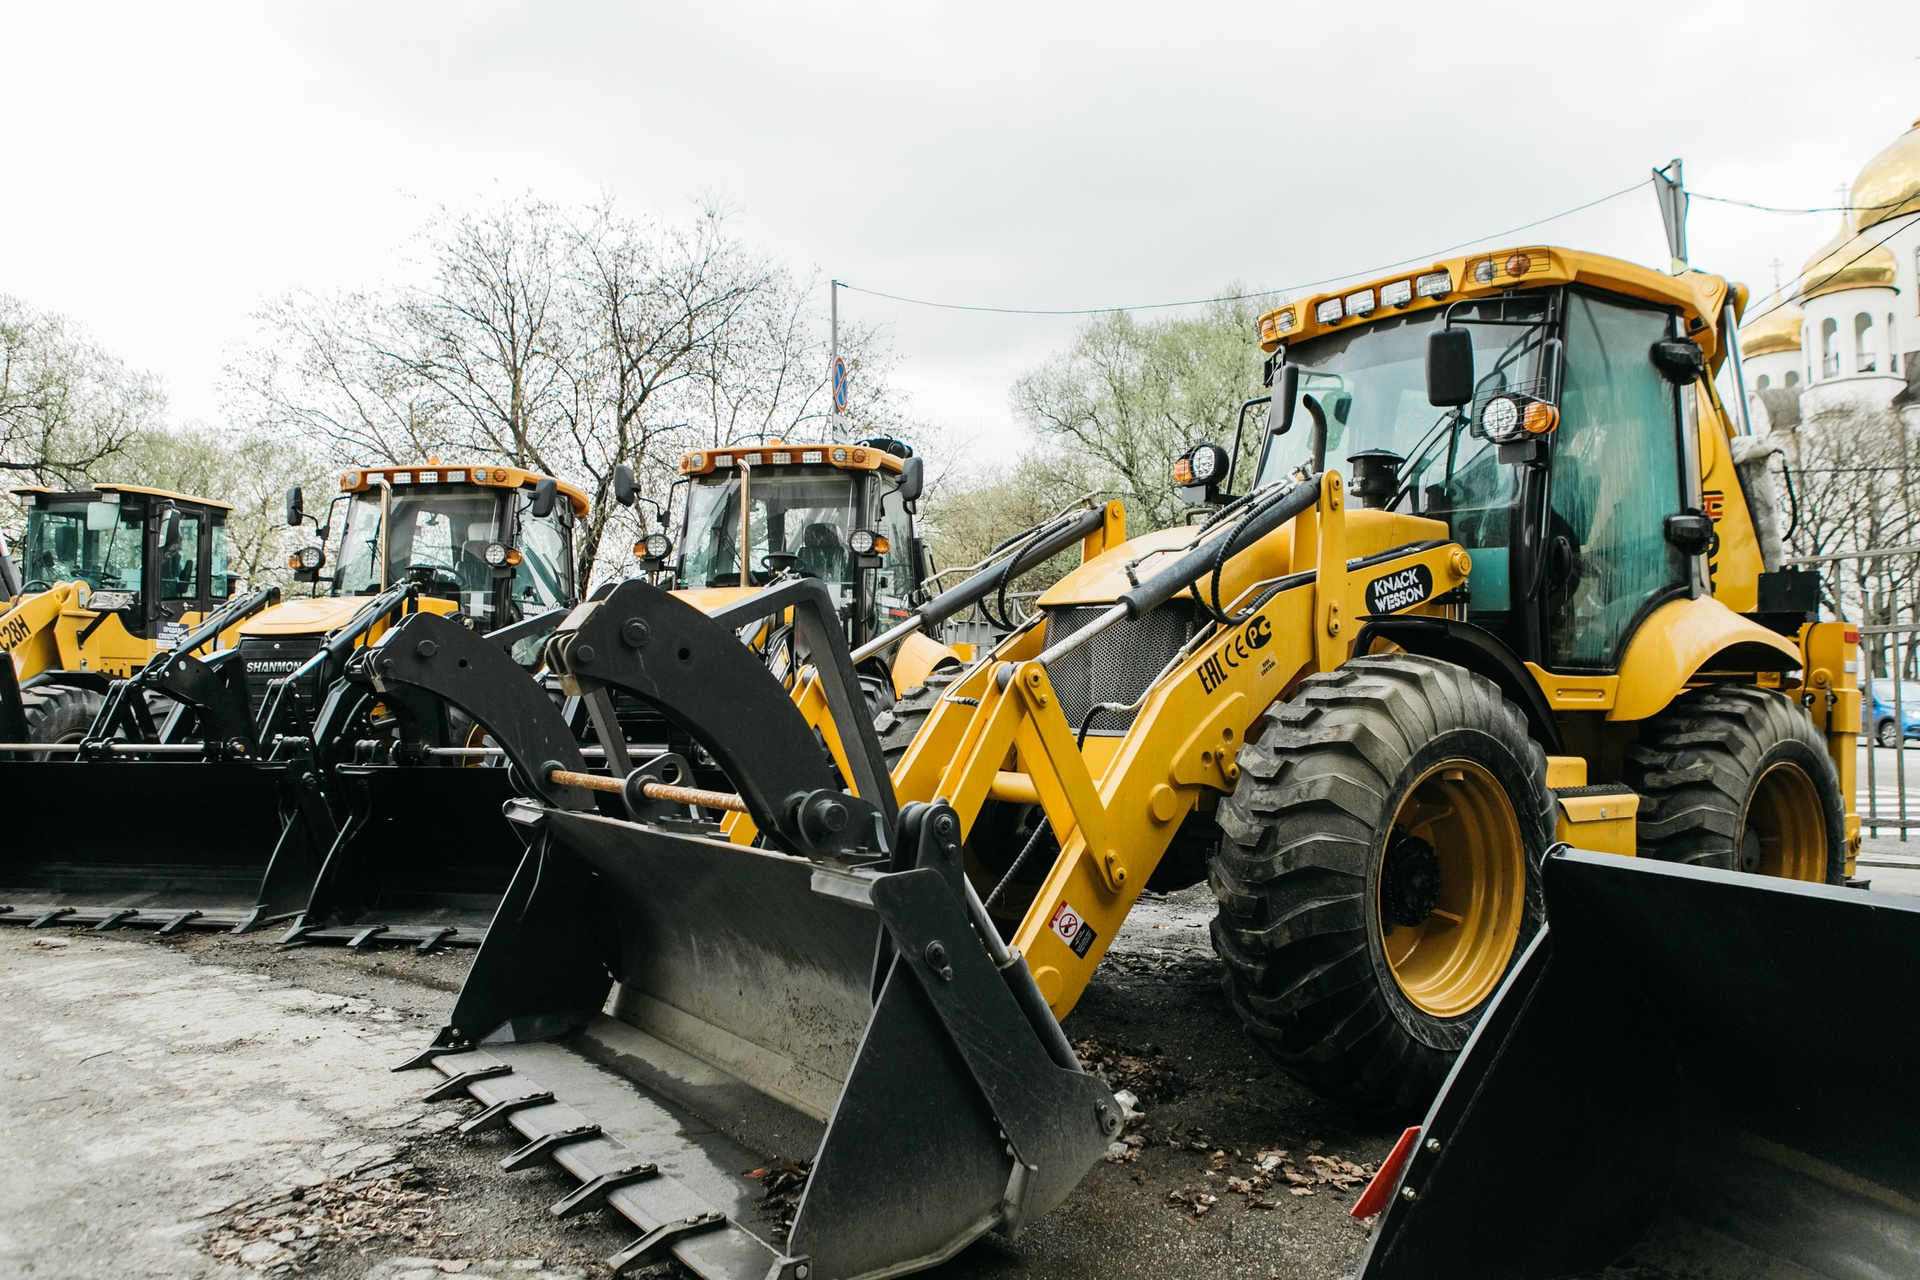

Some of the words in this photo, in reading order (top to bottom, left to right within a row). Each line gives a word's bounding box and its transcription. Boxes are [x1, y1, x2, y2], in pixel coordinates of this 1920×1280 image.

[1374, 568, 1419, 597] KNACK
[1375, 583, 1424, 613] WESSON
[246, 661, 303, 673] SHANMON
